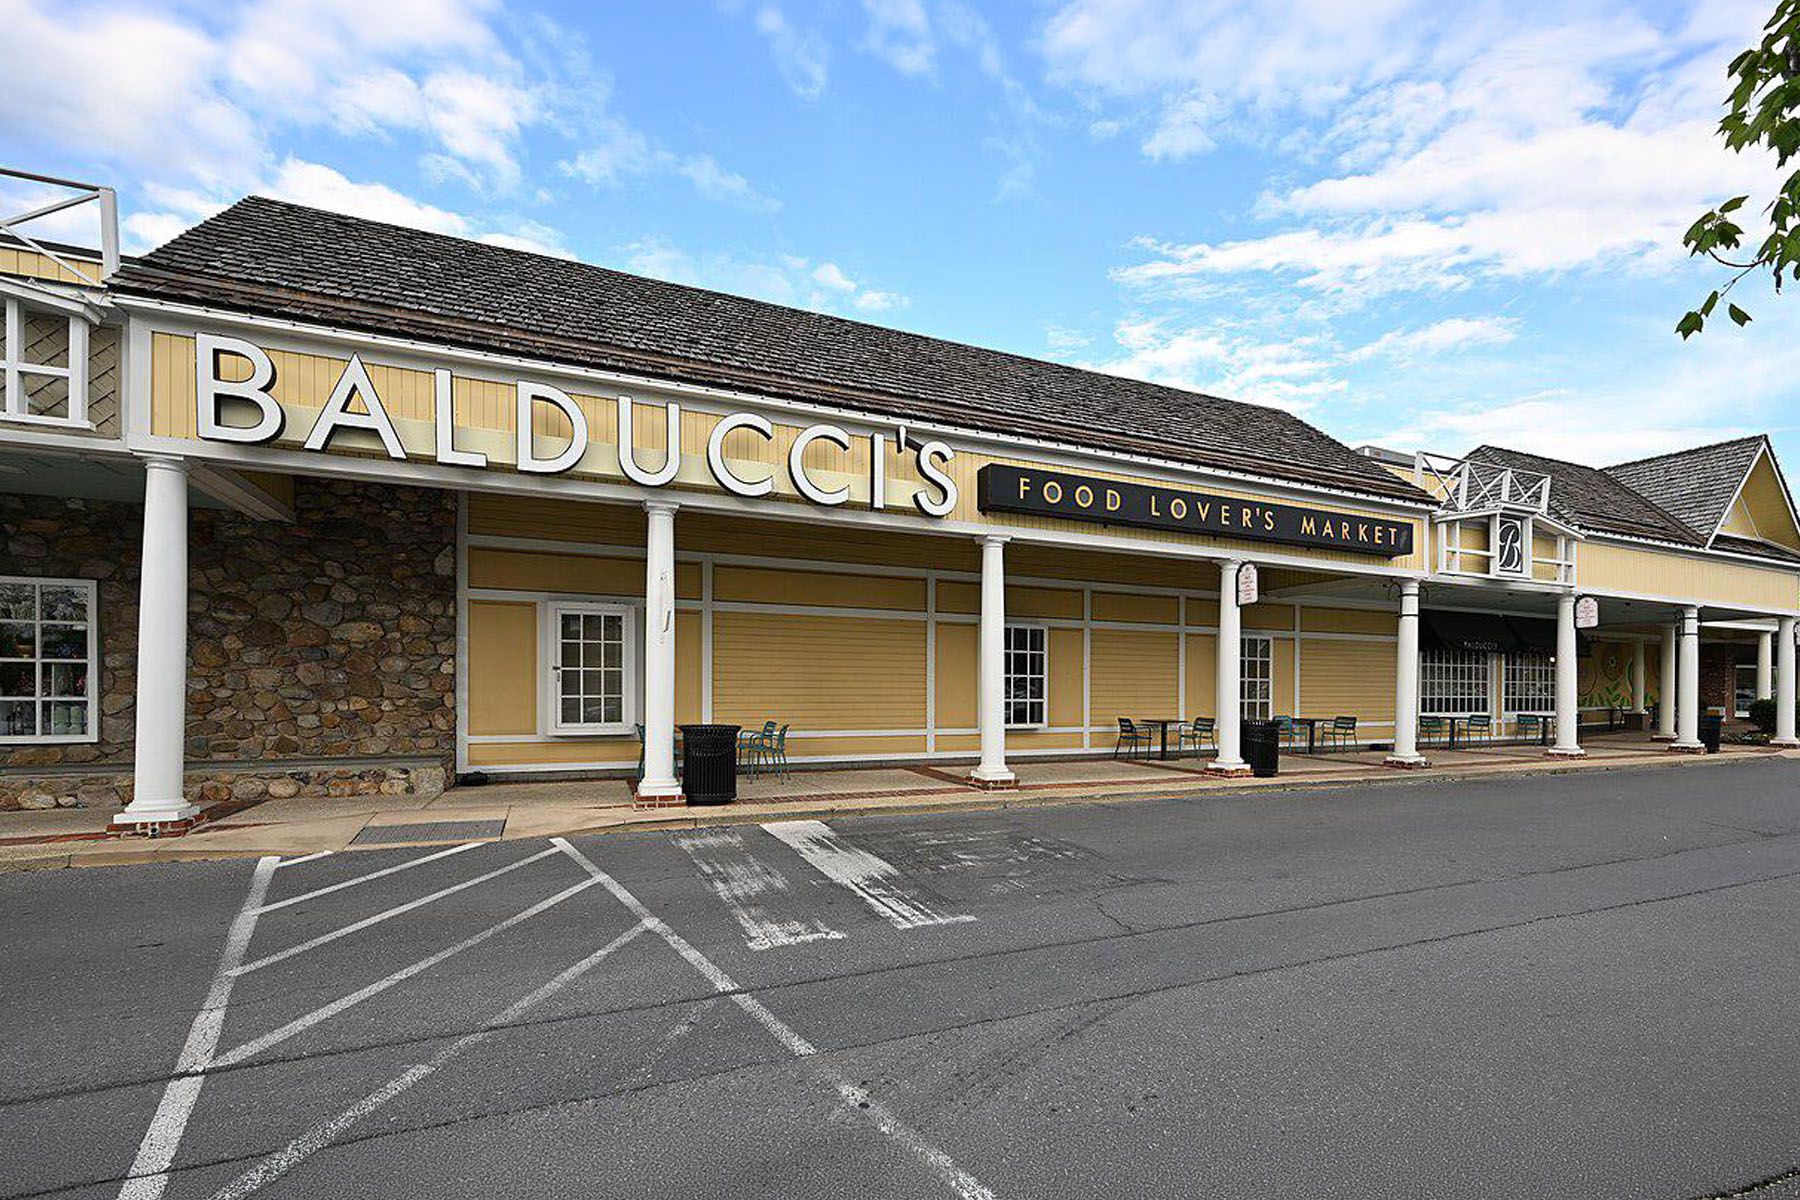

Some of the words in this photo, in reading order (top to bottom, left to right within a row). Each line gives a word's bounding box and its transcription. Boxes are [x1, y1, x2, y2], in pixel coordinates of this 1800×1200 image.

[196, 332, 958, 517] BALDUCCI'S
[1019, 477, 1121, 512] FOOD
[1151, 495, 1275, 531] LOVER'S
[1301, 516, 1397, 545] MARKET
